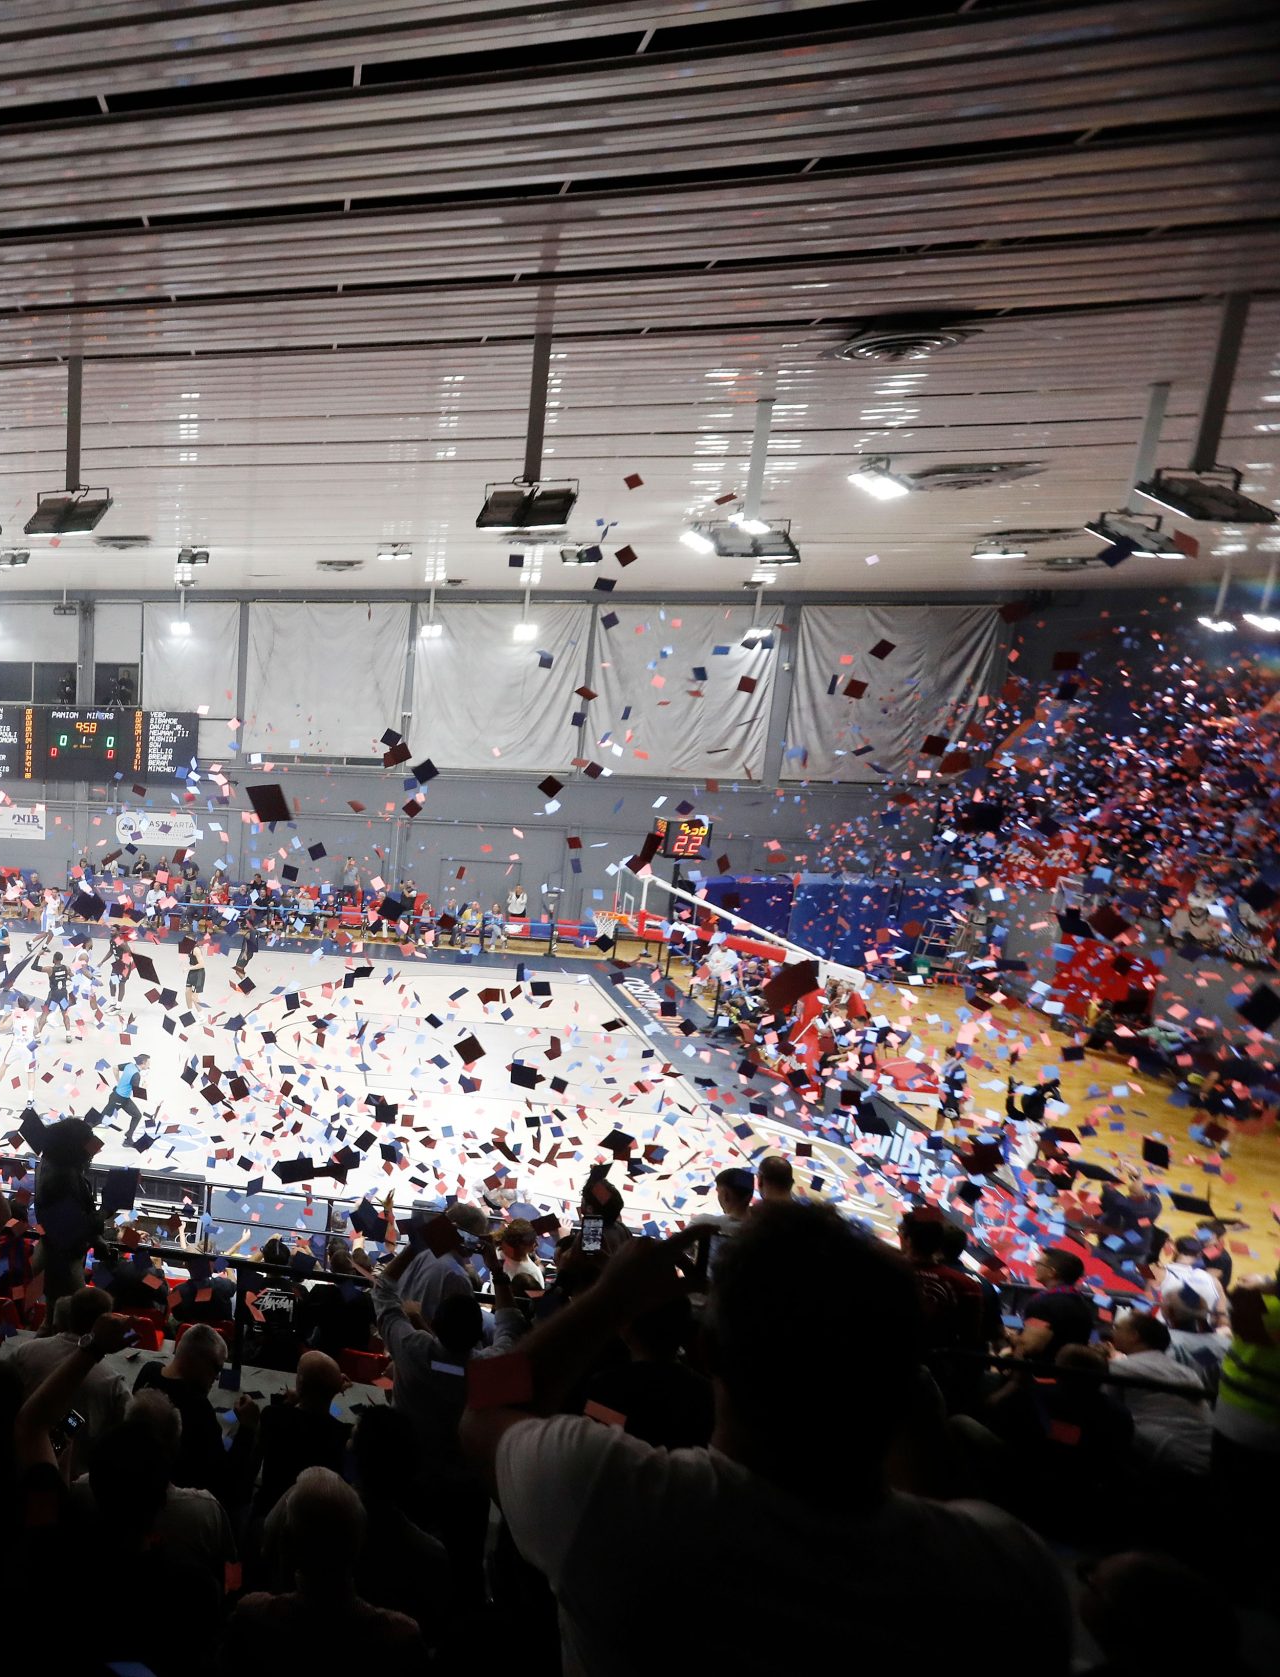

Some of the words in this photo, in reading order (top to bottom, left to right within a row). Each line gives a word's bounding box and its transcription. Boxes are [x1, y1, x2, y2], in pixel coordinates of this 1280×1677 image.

[51, 711, 79, 719] PANION
[76, 722, 97, 733] 9:58
[60, 735, 68, 746] 0
[82, 736, 86, 744] 1
[106, 736, 114, 747] 0
[50, 748, 58, 757] 0
[107, 750, 114, 758] 0
[672, 836, 703, 852] 22
